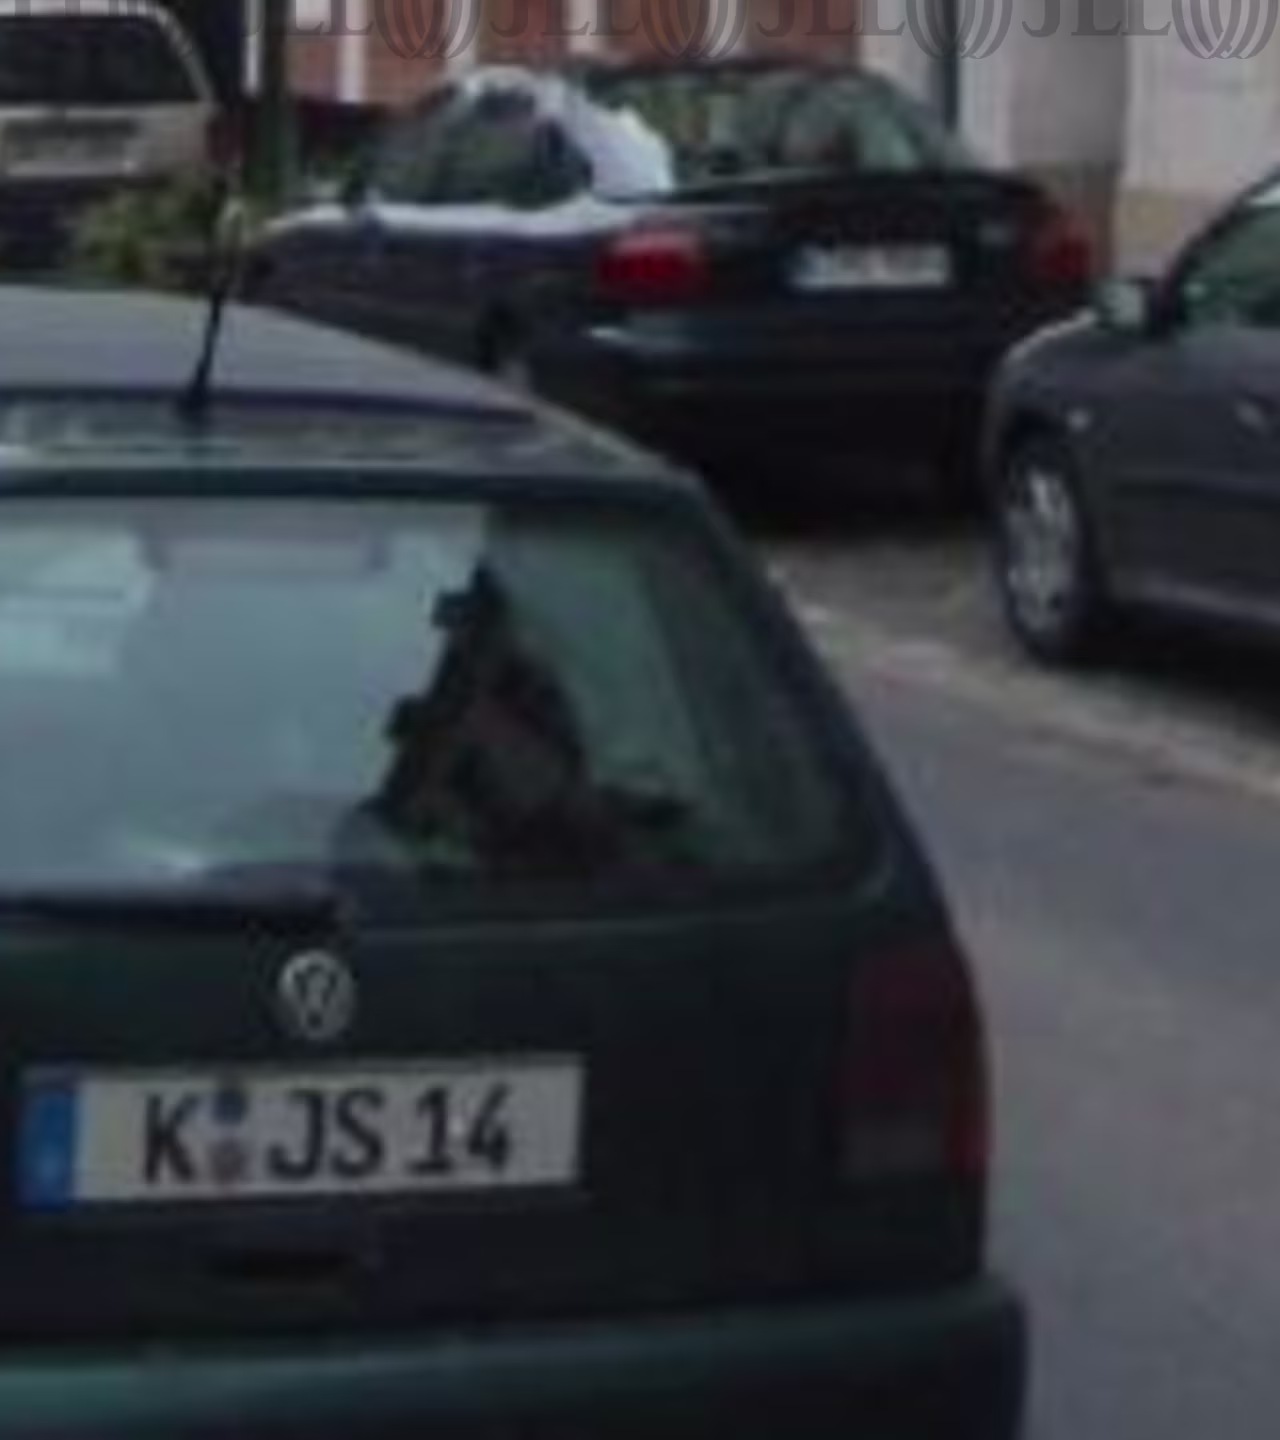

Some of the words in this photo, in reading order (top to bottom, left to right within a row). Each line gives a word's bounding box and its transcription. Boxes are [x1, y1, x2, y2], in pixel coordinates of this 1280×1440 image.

[142, 1092, 199, 1186] K
[266, 1088, 384, 1180] JS
[409, 1083, 513, 1175] 14
